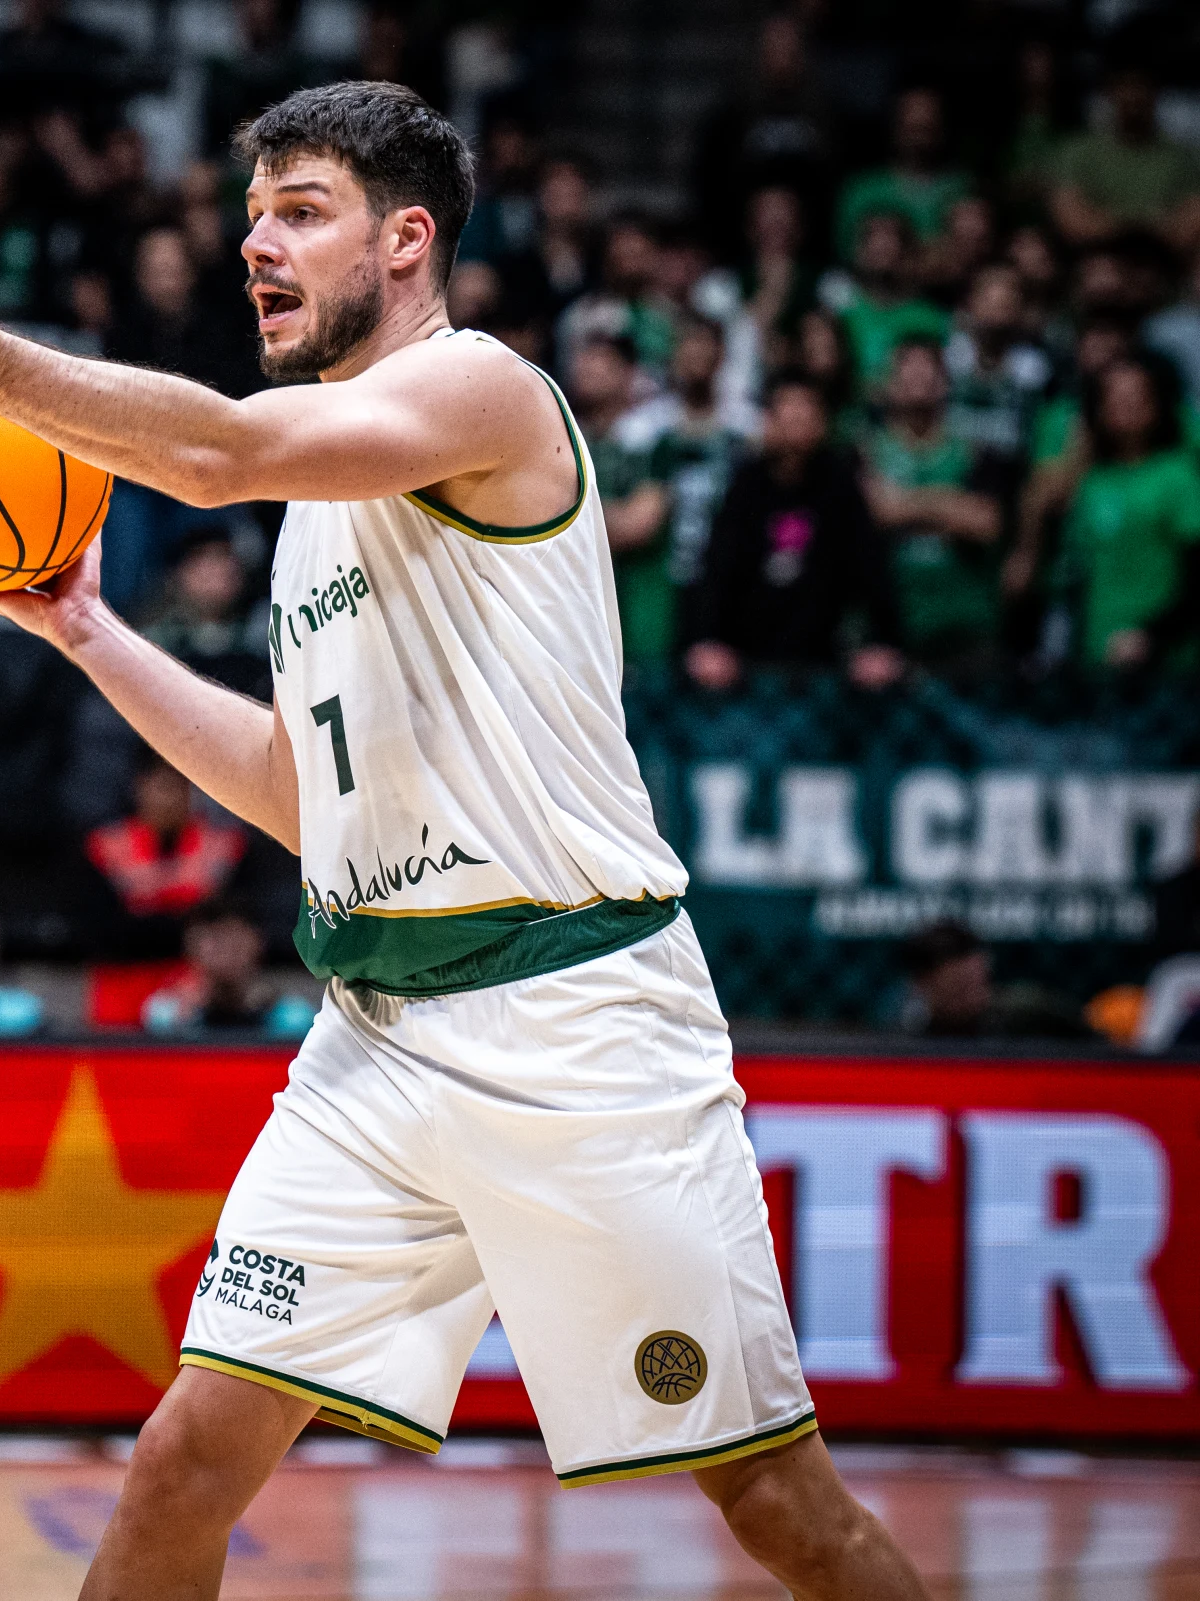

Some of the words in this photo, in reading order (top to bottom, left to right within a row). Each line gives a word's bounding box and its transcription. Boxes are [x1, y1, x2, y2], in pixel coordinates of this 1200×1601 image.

[692, 763, 868, 885] LA
[307, 822, 492, 940] Andalucía
[221, 1267, 254, 1292] DEL
[259, 1279, 300, 1307] SOL
[229, 1244, 306, 1288] COSTA
[214, 1286, 293, 1326] MÁLAGA
